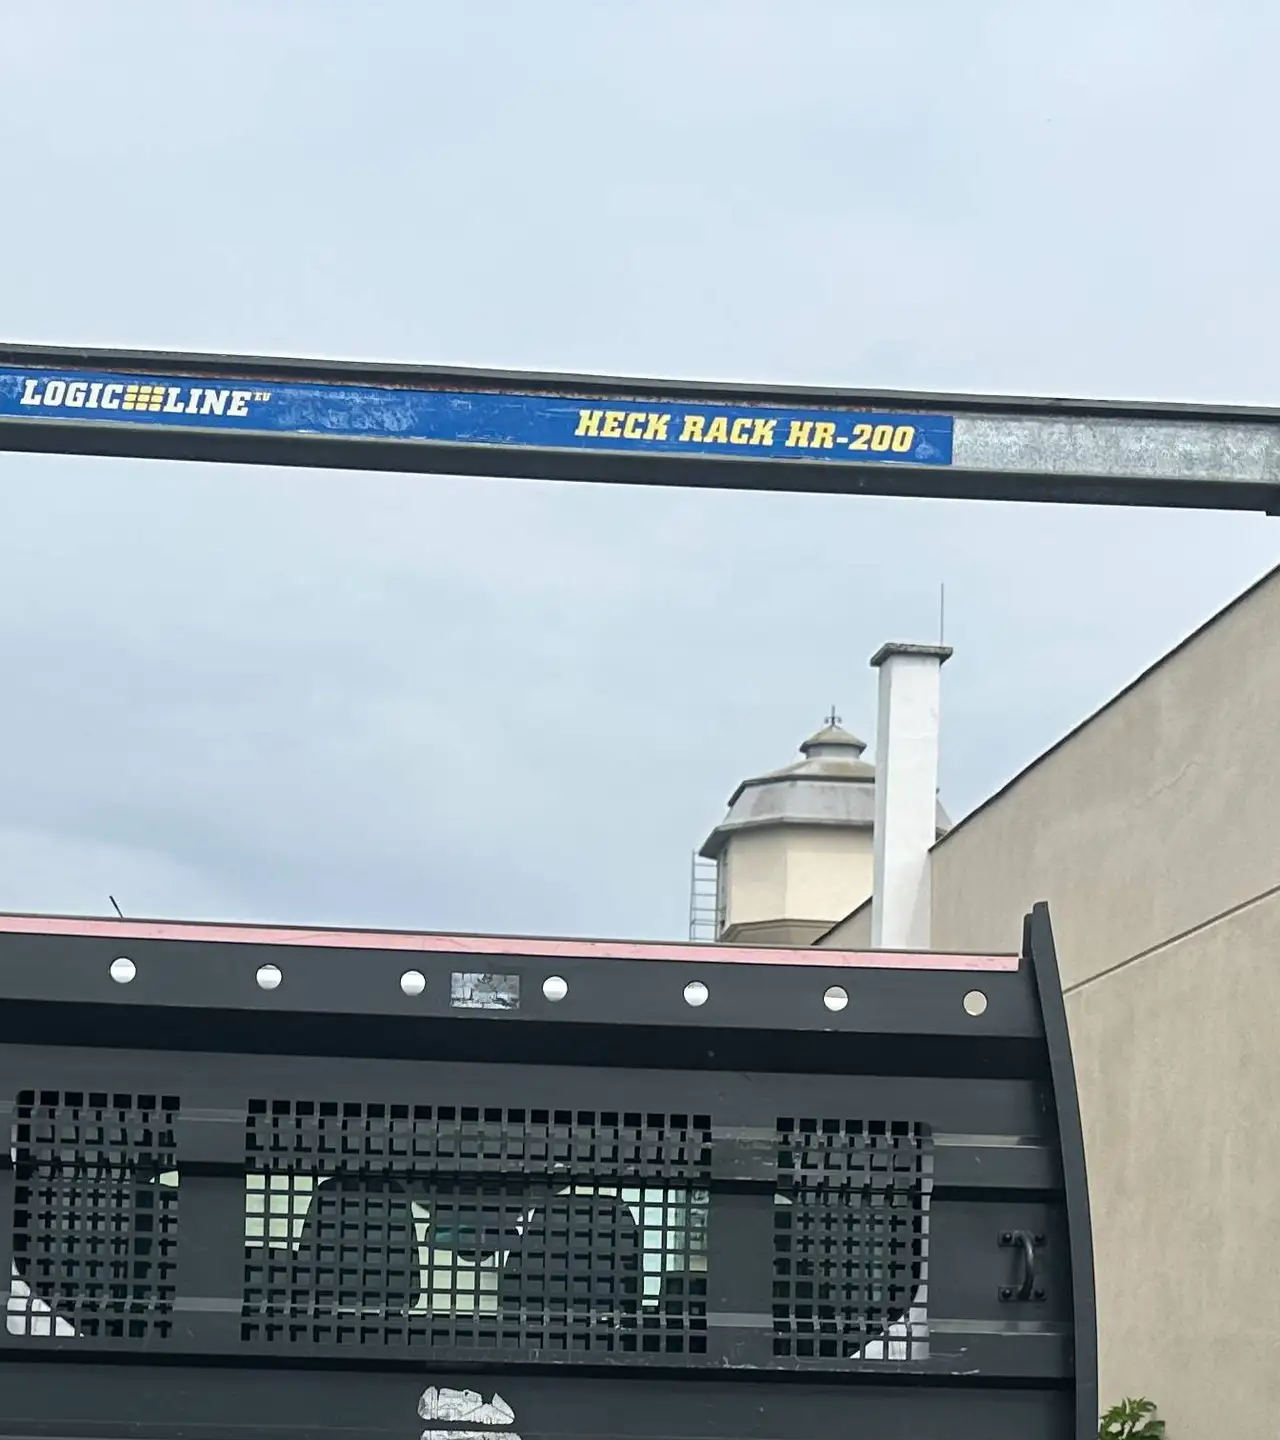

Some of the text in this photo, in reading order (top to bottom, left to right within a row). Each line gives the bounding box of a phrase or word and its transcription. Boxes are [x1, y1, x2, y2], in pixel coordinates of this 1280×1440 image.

[575, 409, 915, 453] HECK RACK HR-200
